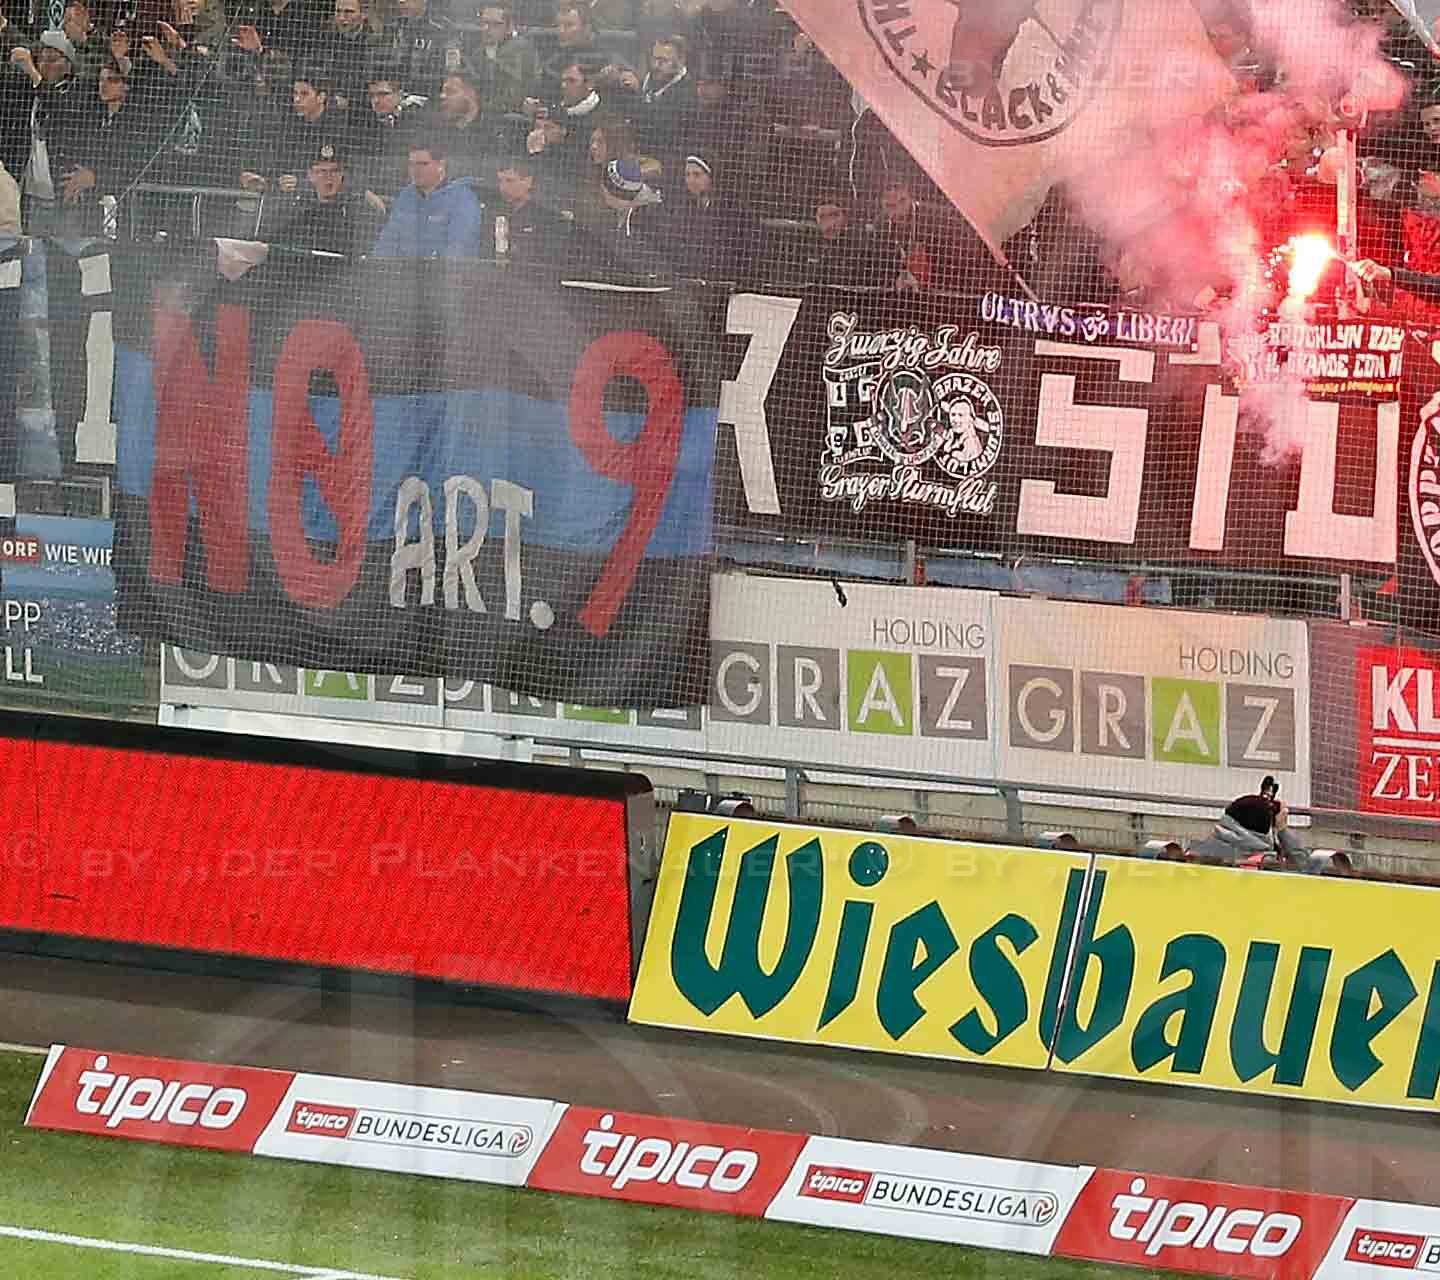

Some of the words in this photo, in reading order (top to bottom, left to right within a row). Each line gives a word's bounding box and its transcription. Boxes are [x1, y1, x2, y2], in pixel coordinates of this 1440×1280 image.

[568, 330, 685, 635] 9
[2, 539, 38, 558] ORF
[45, 543, 80, 564] WIE
[390, 474, 555, 630] ART.
[872, 617, 987, 649] HOLDING
[1178, 644, 1295, 679] HOLDING
[717, 651, 977, 732] GRAZ
[1016, 673, 1285, 762] GRAZ
[71, 1053, 247, 1131] tipico
[293, 1104, 351, 1137] tipico
[354, 1110, 509, 1152] BUNDESLIGA
[578, 1111, 761, 1193] tipico
[804, 1165, 868, 1200] tipico
[870, 1175, 1031, 1224] BUNDESLIGA
[1107, 1176, 1304, 1258] tipico
[1356, 1230, 1421, 1264] tipico
